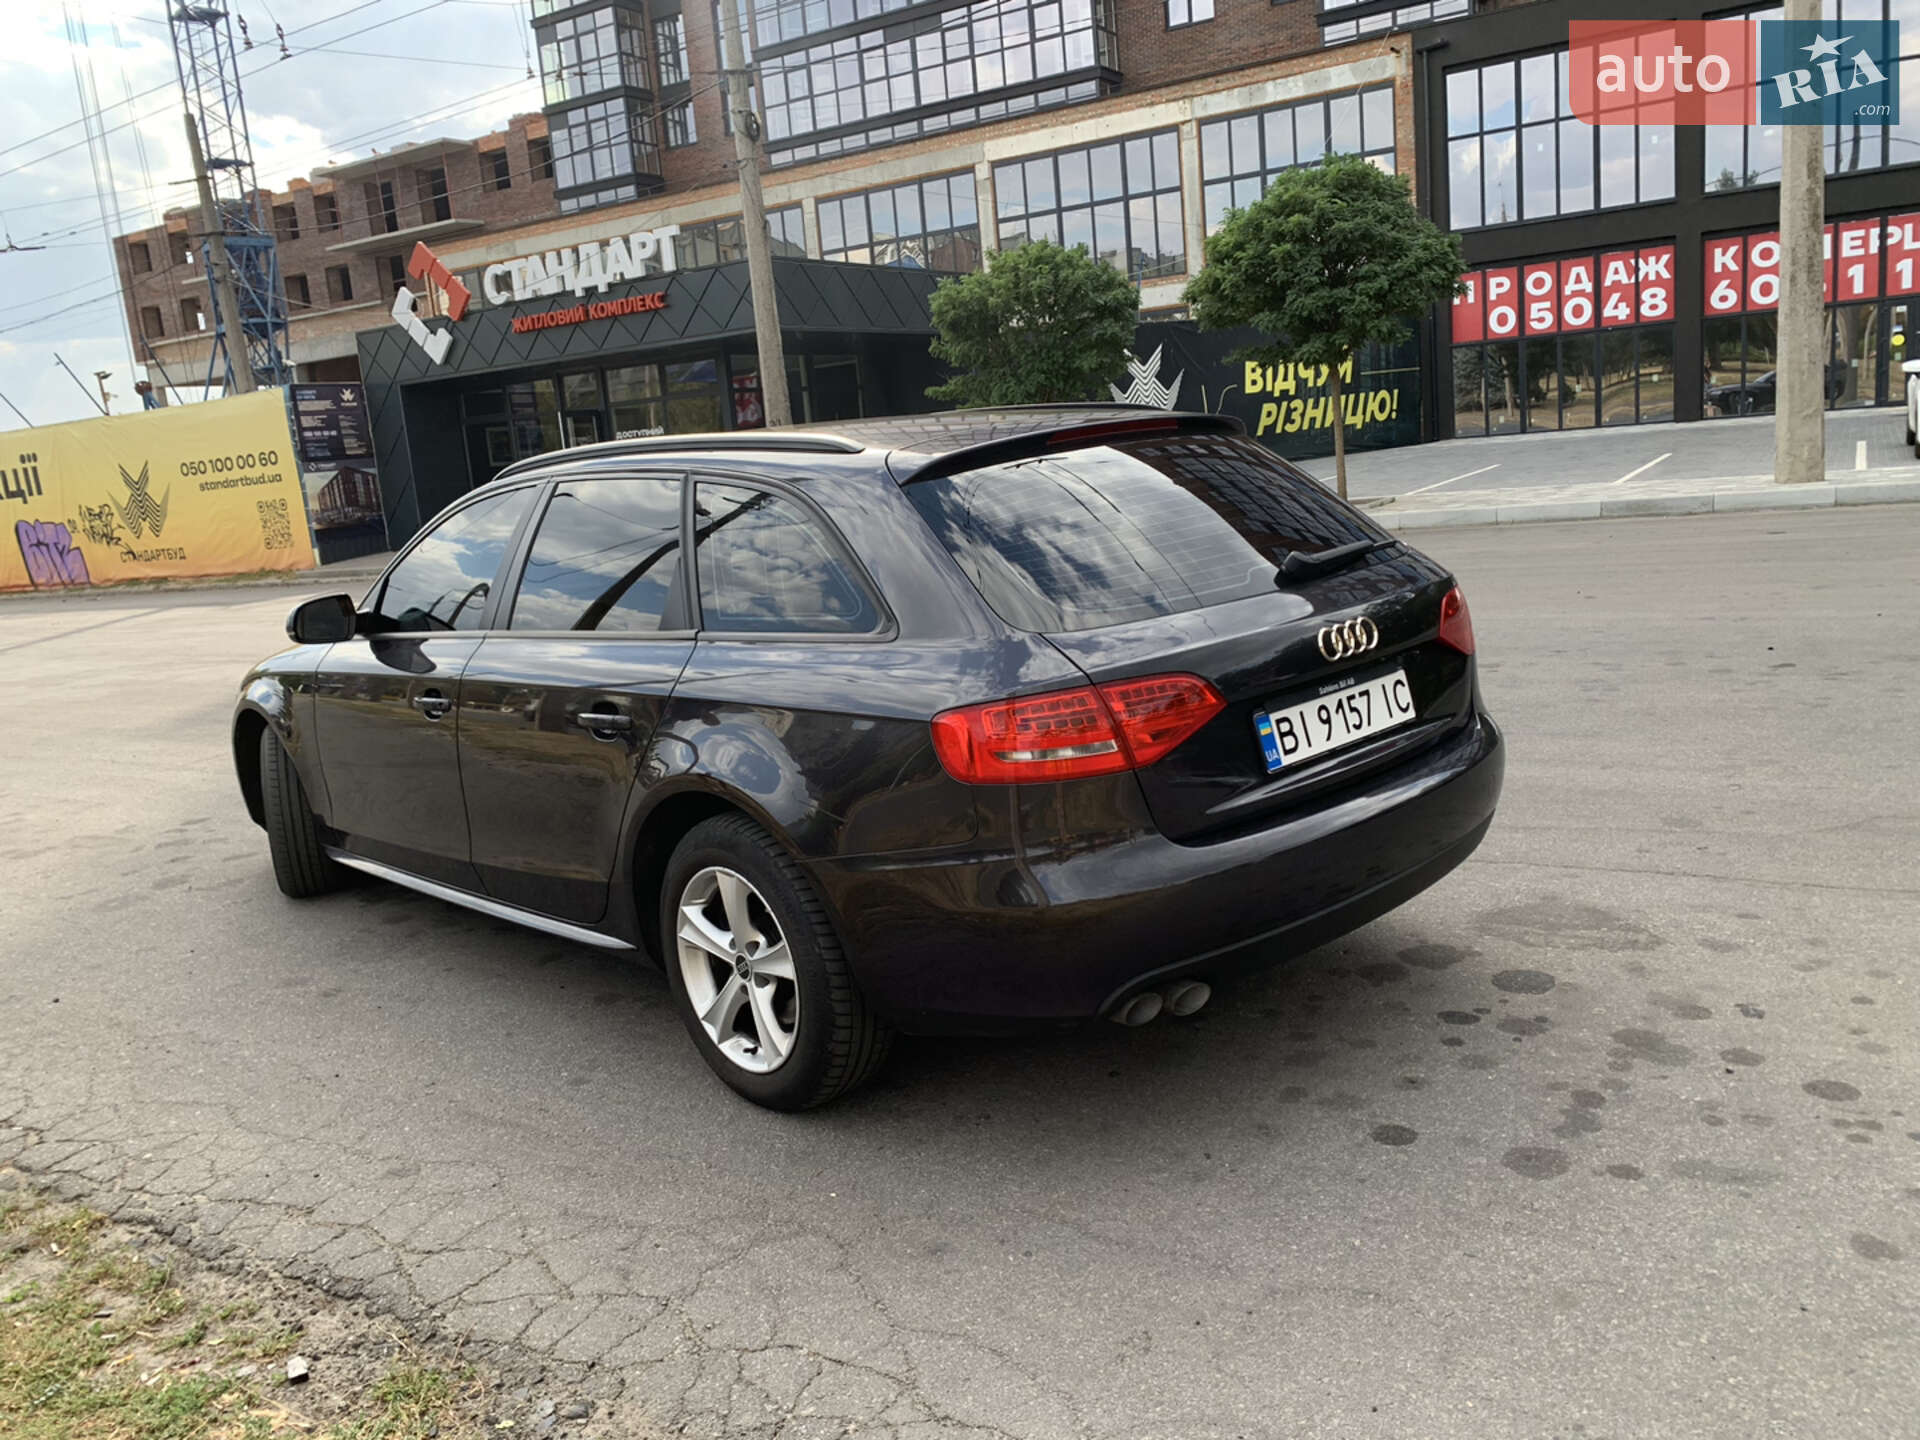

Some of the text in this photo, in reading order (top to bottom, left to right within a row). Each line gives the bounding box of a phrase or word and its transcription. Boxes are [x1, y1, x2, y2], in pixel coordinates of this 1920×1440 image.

[483, 224, 680, 305] СТАНДАРТ
[512, 291, 668, 334] ЖИТЛОВИЙ КОМПЛЕКС
[0, 452, 43, 504] ції
[180, 450, 279, 477] 050 100 00 60
[199, 473, 283, 491] standartbud.ua
[1275, 679, 1410, 756] BI 9157 IC
[1265, 748, 1280, 763] UA
